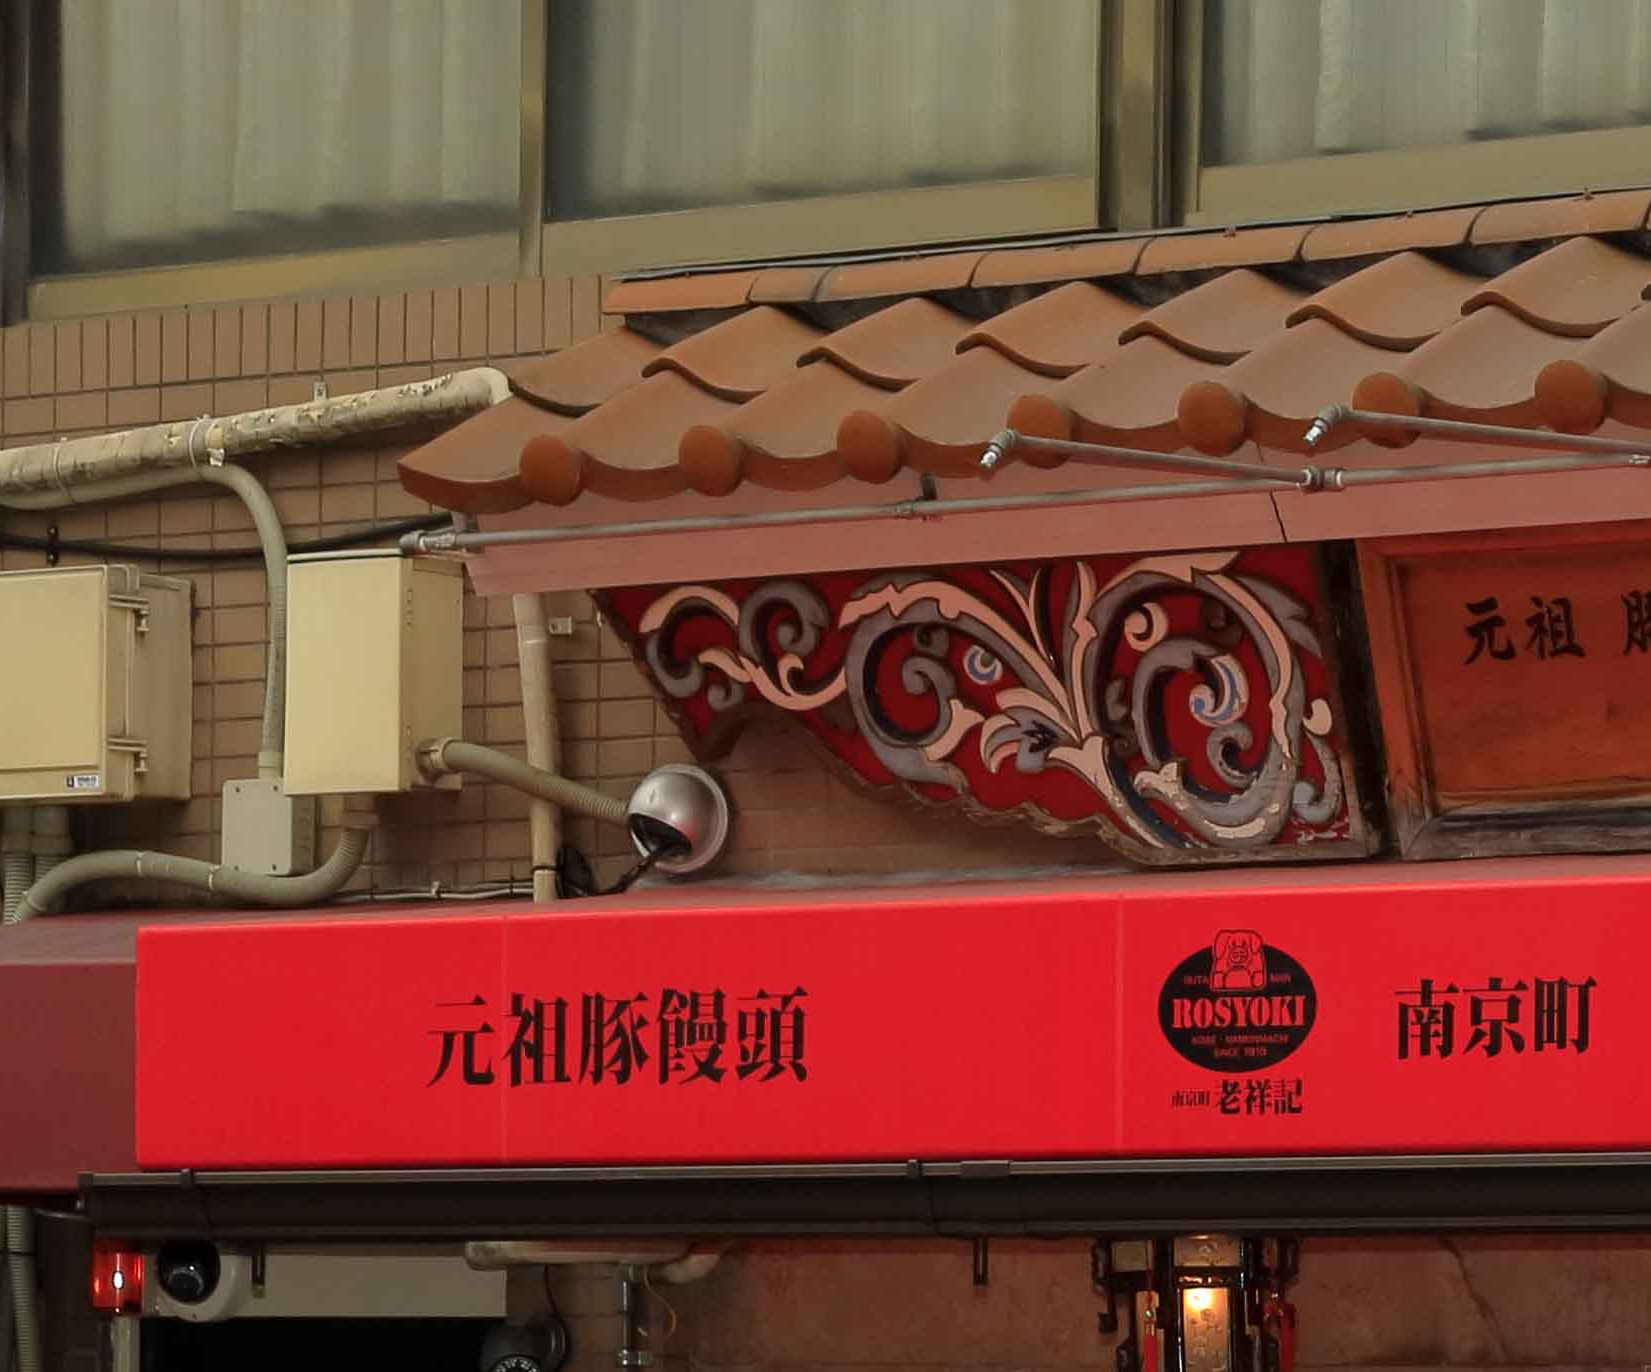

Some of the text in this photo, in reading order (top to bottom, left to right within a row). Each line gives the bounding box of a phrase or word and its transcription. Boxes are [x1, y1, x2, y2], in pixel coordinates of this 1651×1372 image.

[1462, 592, 1586, 665] 元祖
[426, 986, 810, 1087] 元祖豚饅頭
[1172, 994, 1306, 1029] ROSYOKI
[1395, 975, 1597, 1061] 南京町
[1216, 1078, 1304, 1115] 老祥記
